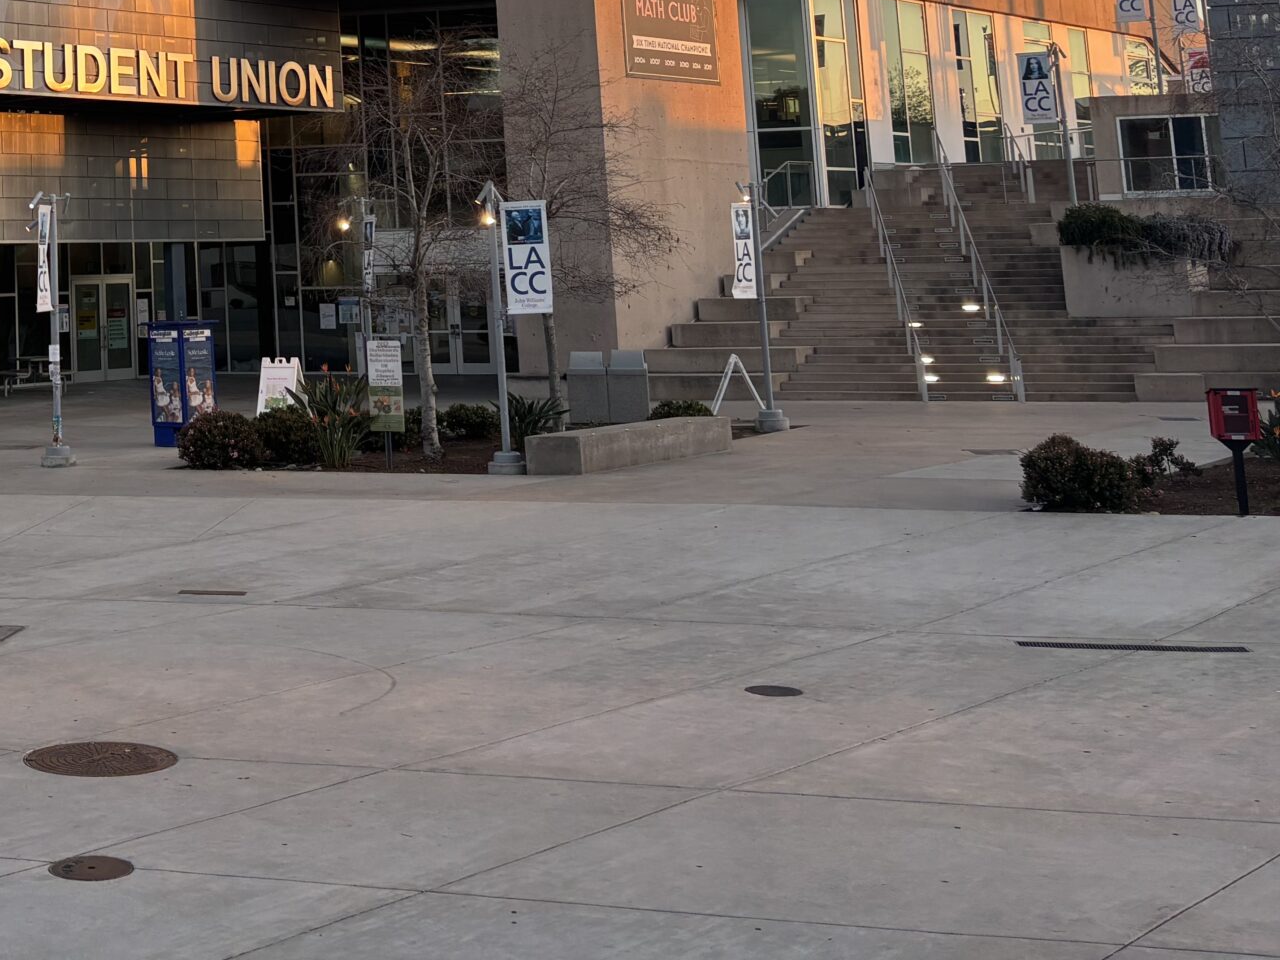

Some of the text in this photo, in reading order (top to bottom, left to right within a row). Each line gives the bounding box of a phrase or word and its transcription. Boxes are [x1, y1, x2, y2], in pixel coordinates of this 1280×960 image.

[668, 1, 697, 23] CLUB
[1174, 10, 1196, 24] CC
[658, 41, 680, 51] NATIONAL
[211, 55, 335, 108] UNION
[1190, 69, 1211, 82] LA
[1022, 80, 1050, 97] LA
[1192, 81, 1212, 94] CC
[1024, 96, 1052, 112] CC
[507, 246, 546, 270] LA
[735, 241, 752, 262] LA
[736, 262, 753, 283] CC
[510, 270, 547, 295] CC
